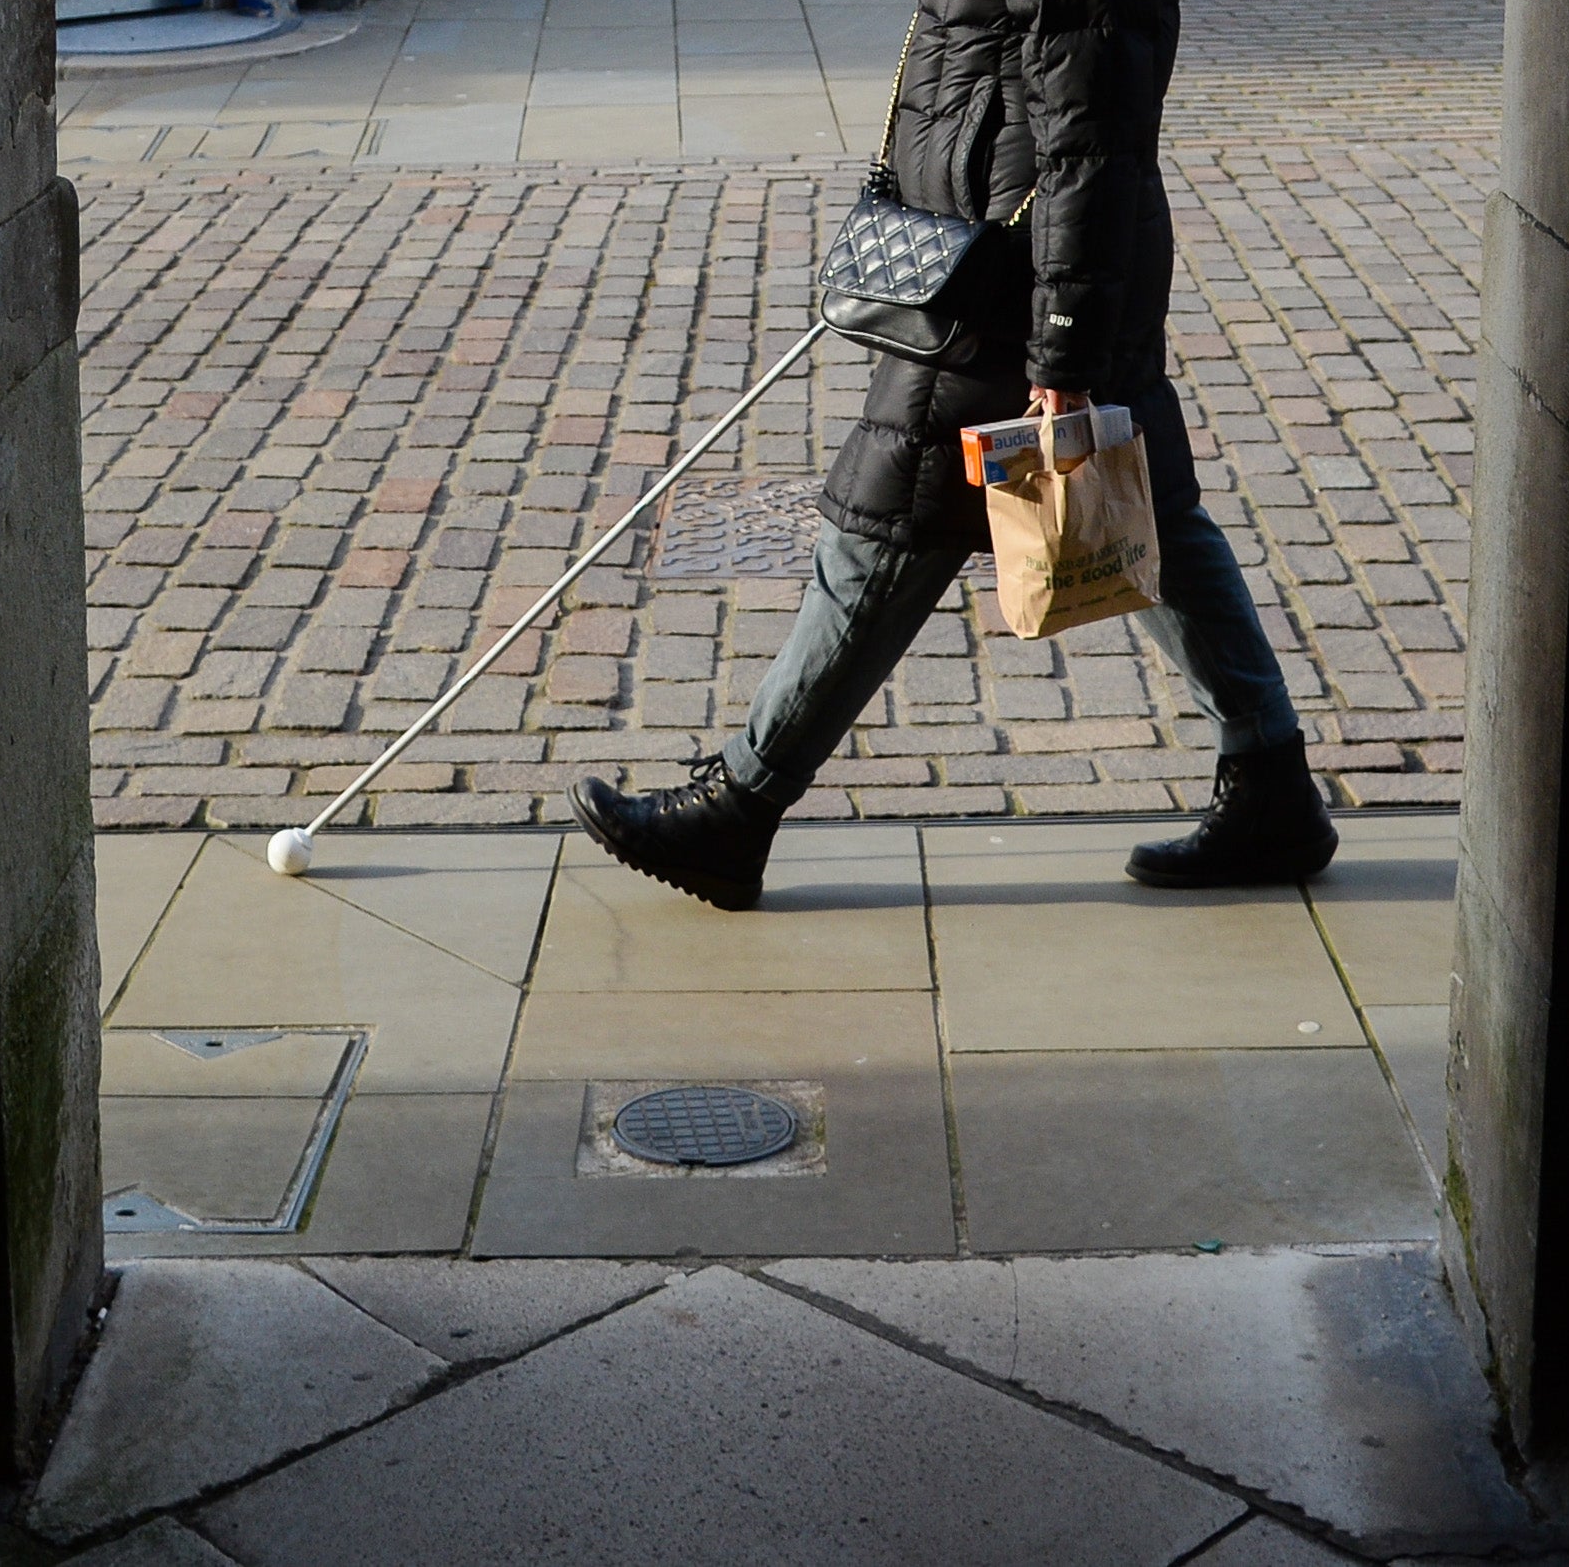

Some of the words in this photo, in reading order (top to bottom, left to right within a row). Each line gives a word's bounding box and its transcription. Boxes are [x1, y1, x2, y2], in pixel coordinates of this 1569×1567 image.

[994, 426, 1067, 450] audicln
[1044, 574, 1075, 591] the
[1080, 556, 1124, 585] good
[1125, 542, 1148, 566] life
